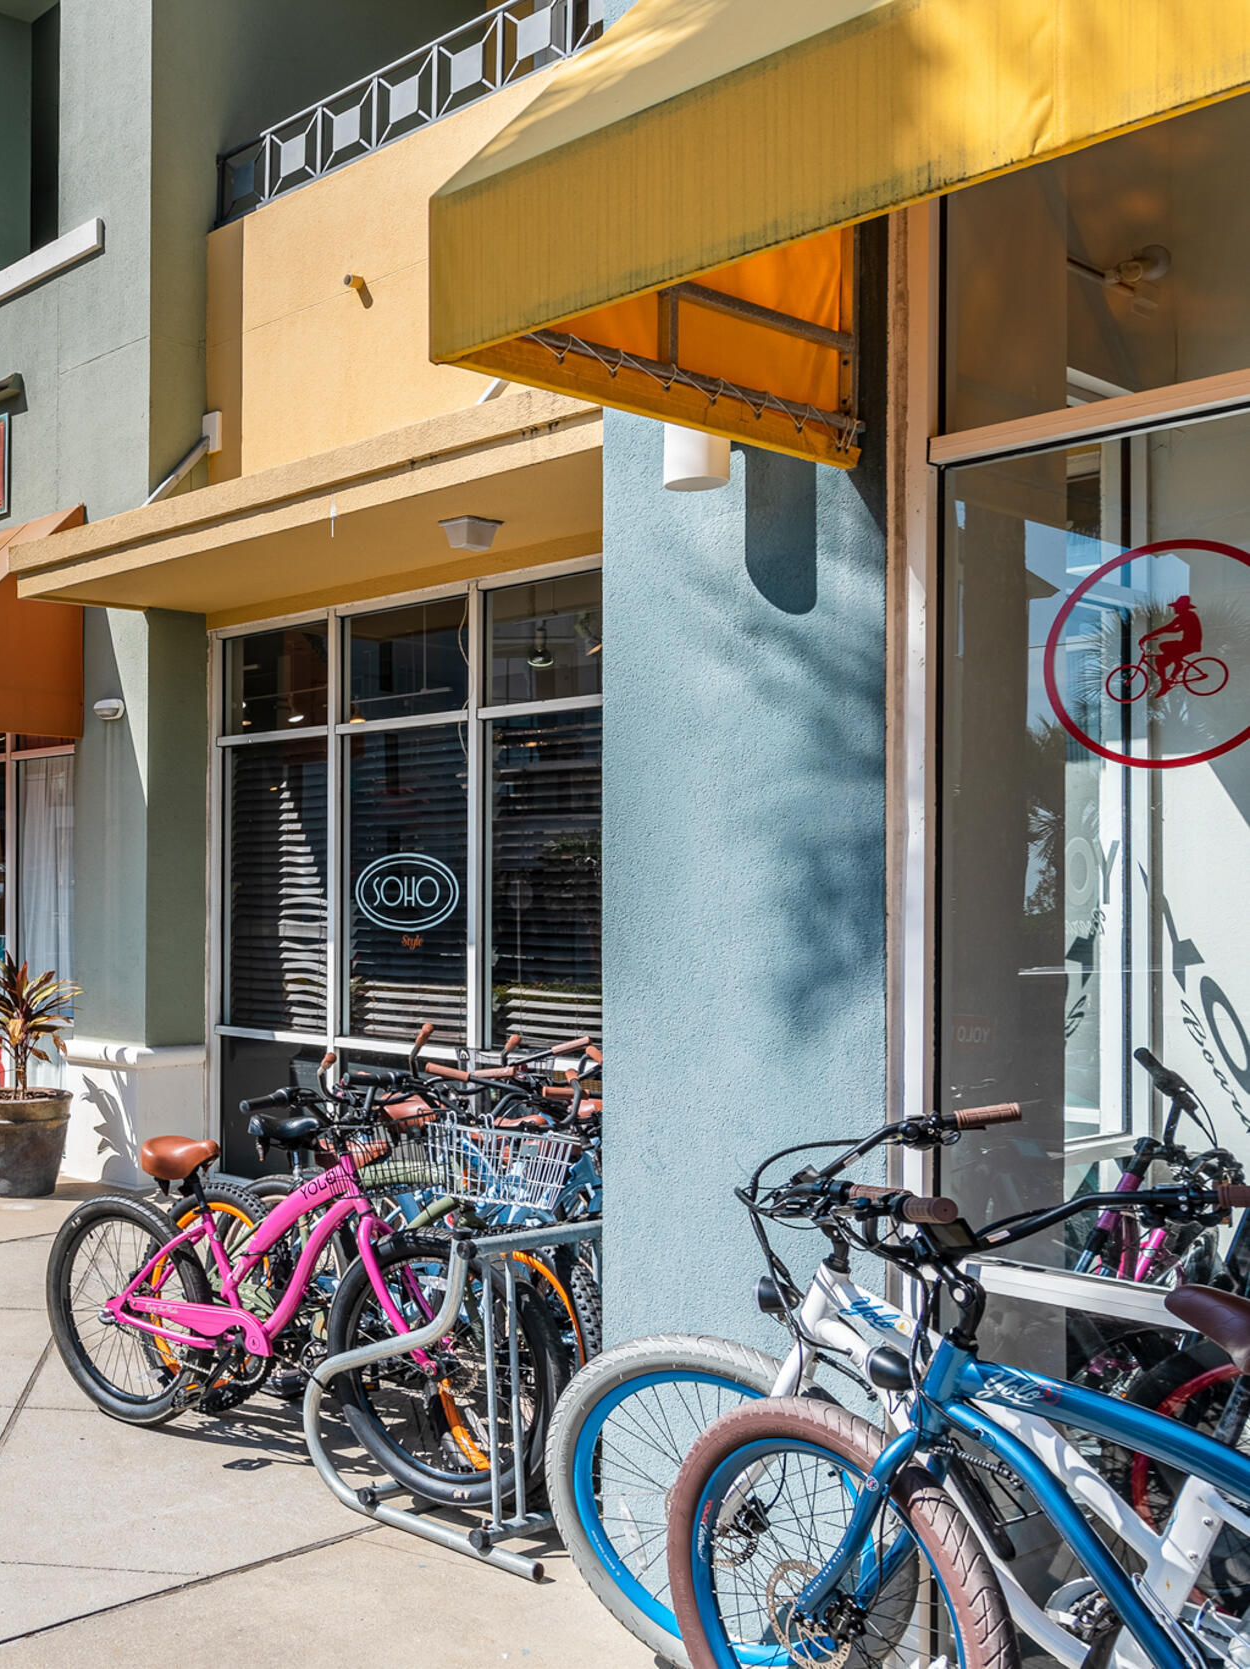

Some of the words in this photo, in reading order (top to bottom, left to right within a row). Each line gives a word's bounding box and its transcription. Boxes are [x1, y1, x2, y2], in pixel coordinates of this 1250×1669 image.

[373, 876, 440, 907] SOHO
[401, 935, 424, 951] Style
[300, 1170, 336, 1200] YOLO
[839, 1296, 901, 1332] Yolo
[975, 1369, 1043, 1406] Yolo
